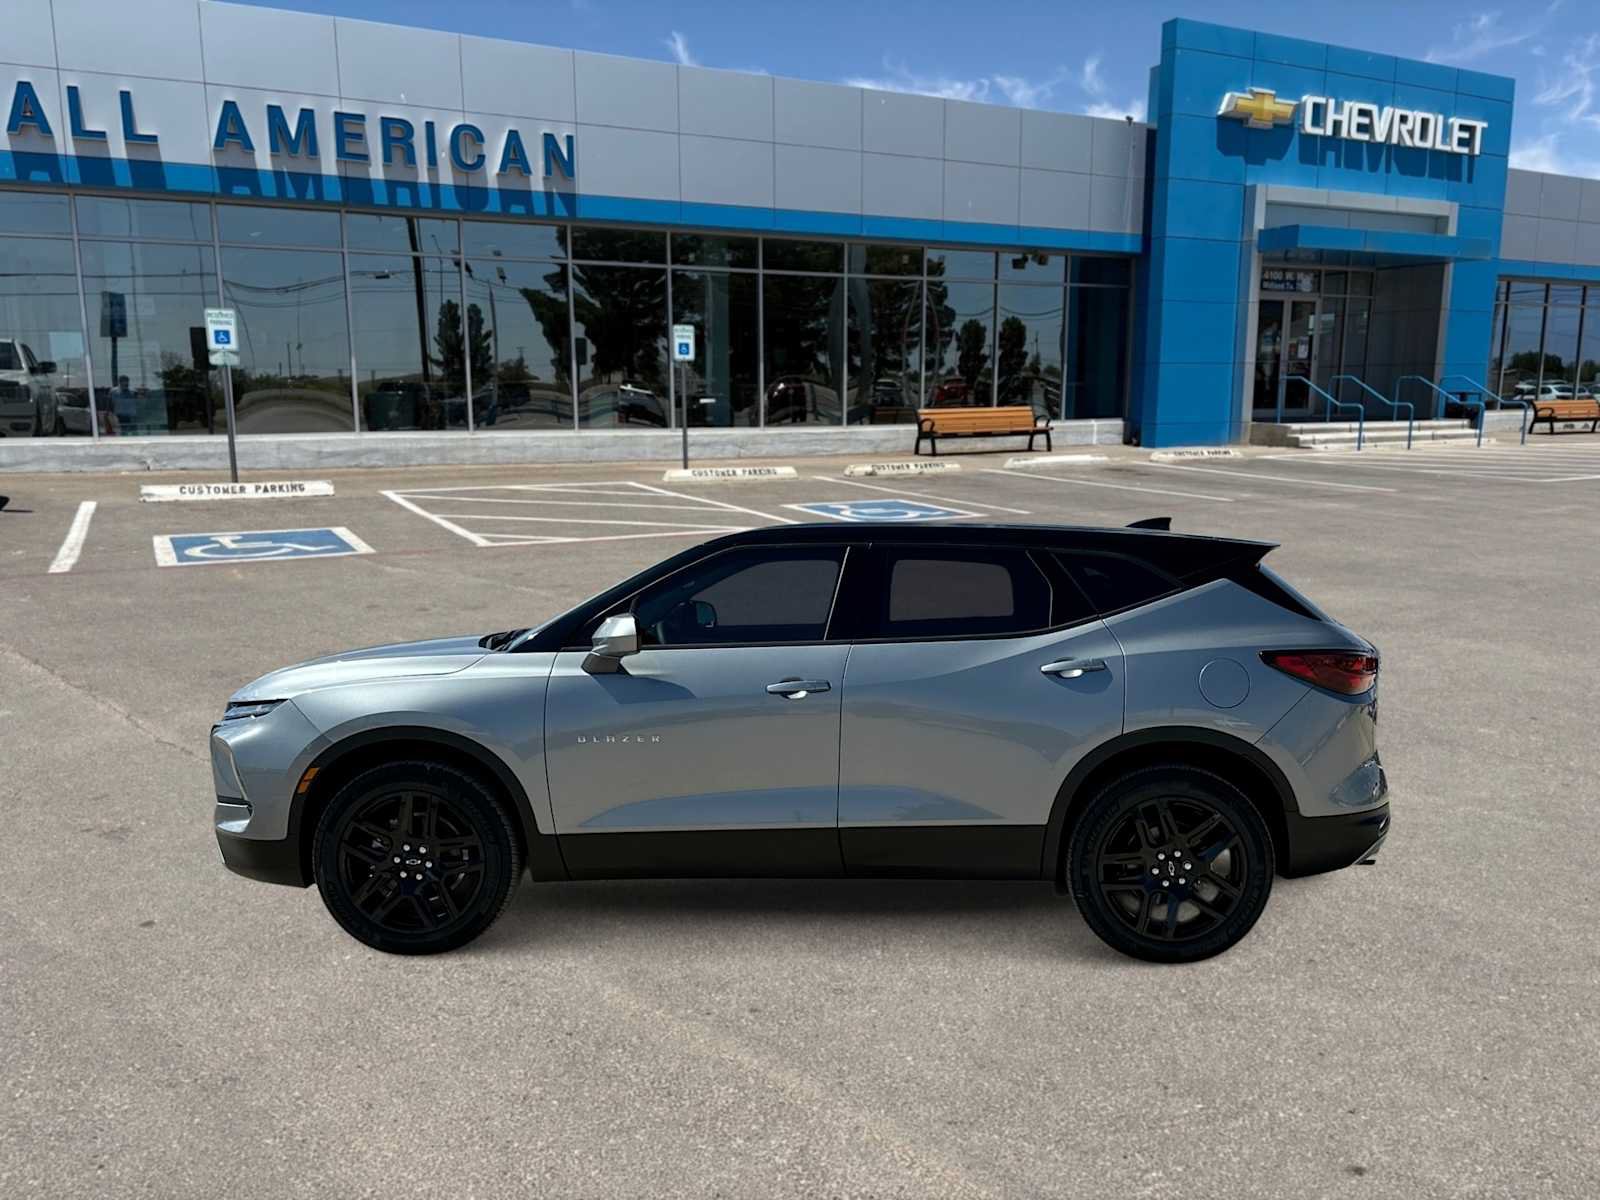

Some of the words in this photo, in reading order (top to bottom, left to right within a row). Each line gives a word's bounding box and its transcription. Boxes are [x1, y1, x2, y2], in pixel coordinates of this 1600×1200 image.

[6, 79, 159, 145] ALL
[212, 98, 576, 180] AMERICAN
[1302, 94, 1489, 156] CHEVROLET
[691, 469, 737, 477] CUSTOMER
[742, 468, 777, 476] PARKING
[179, 485, 247, 495] CUSTOMER
[254, 483, 306, 494] PARKING
[577, 735, 661, 743] BLAZER
